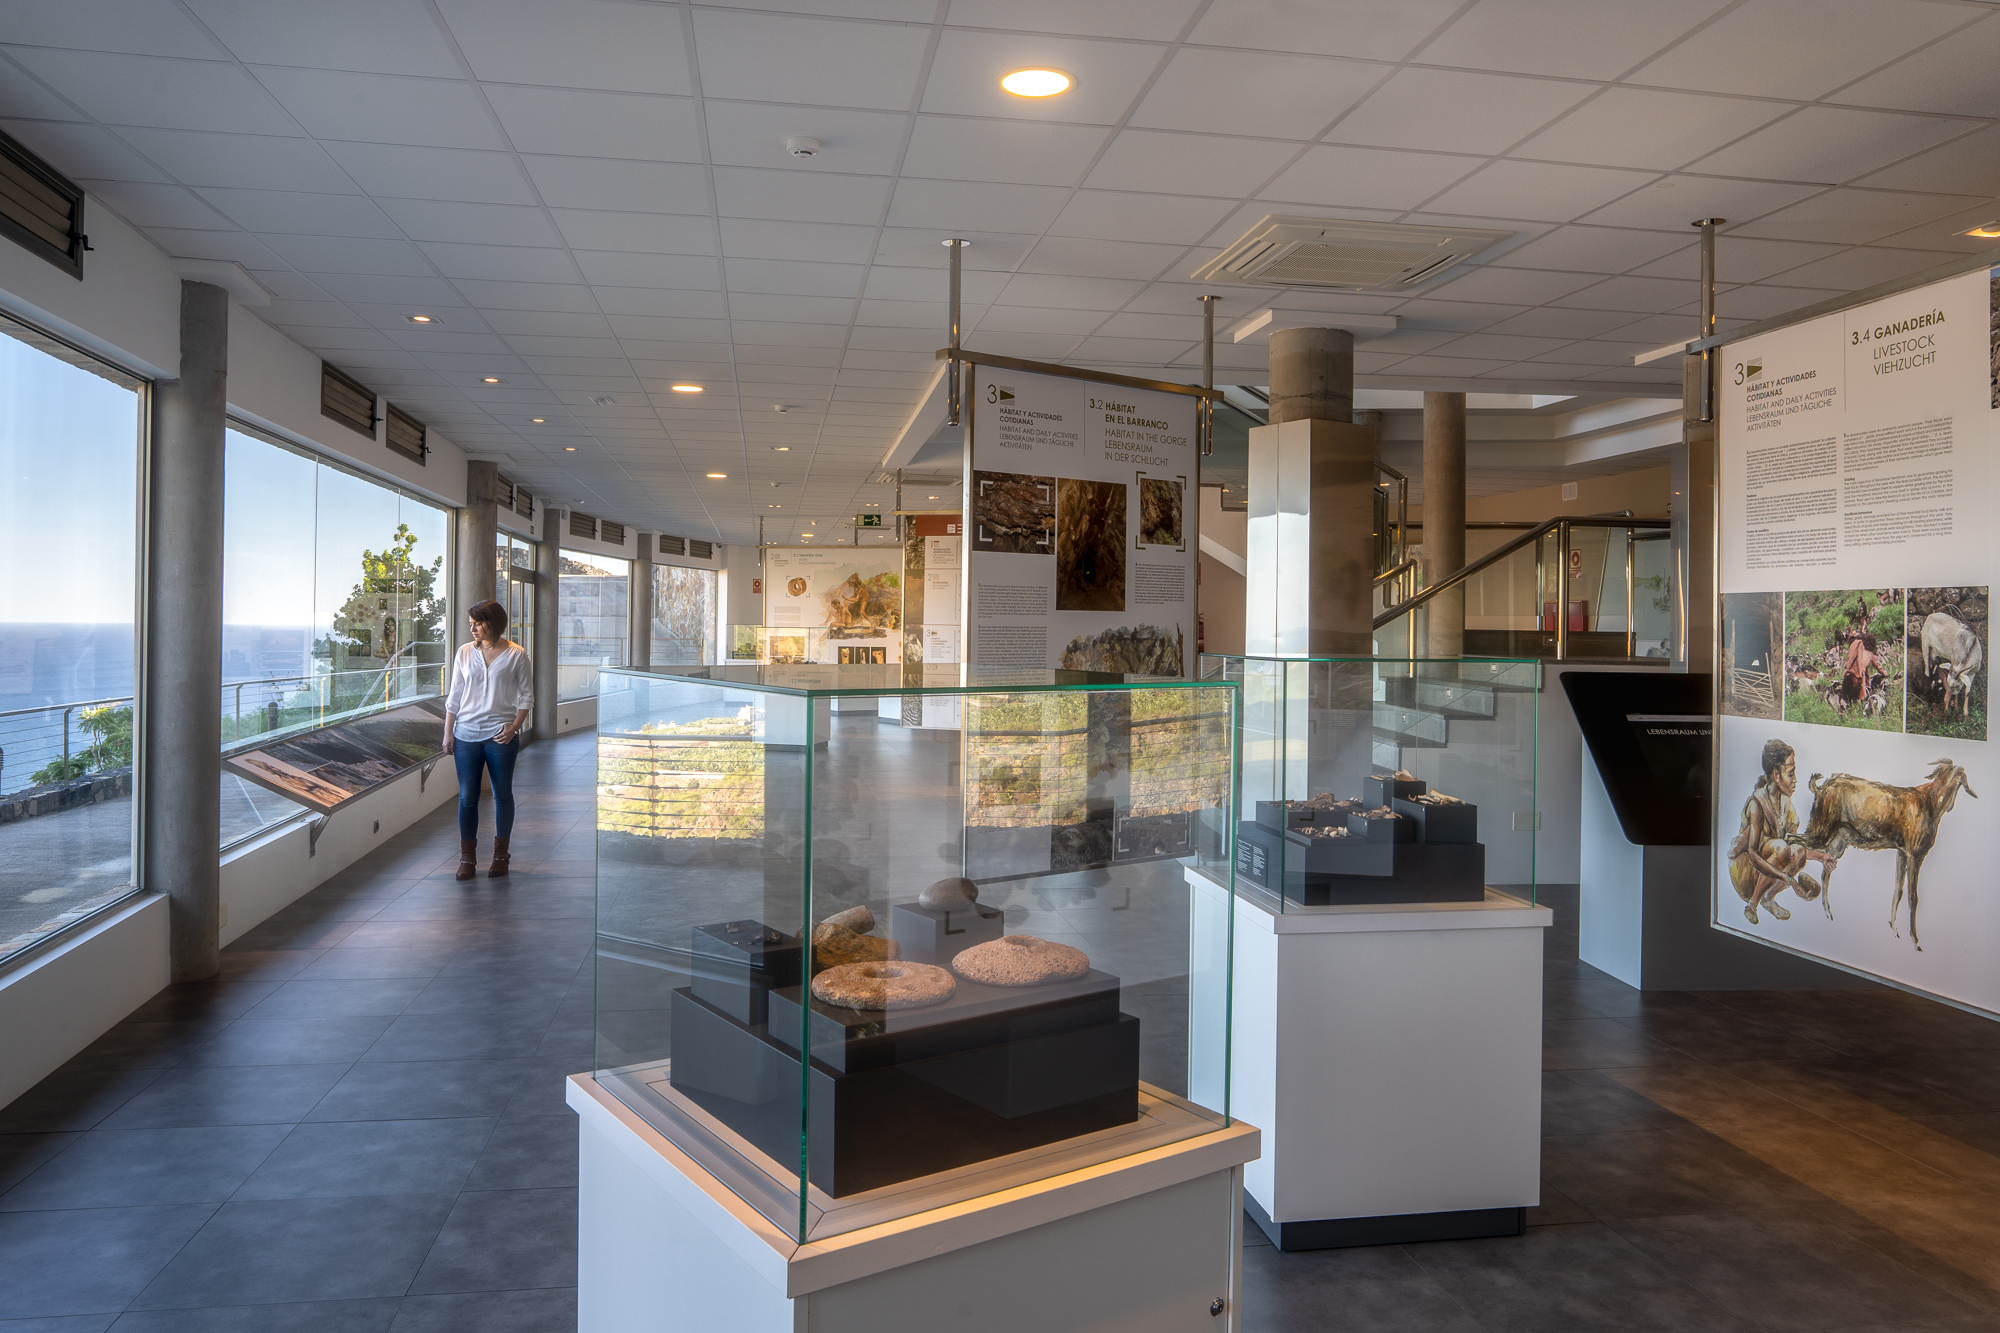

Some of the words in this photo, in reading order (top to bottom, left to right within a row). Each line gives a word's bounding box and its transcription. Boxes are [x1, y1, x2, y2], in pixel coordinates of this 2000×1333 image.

[1852, 328, 1870, 345] 3.4
[1874, 309, 1945, 339] GANADERÍA
[1874, 334, 1935, 360] LIVESTOCK
[1874, 351, 1936, 375] VIEHZUCHT
[1735, 363, 1744, 385] 3
[1747, 381, 1769, 393] HÁBITAT
[1776, 370, 1816, 386] ACTIVIDADES
[987, 384, 997, 404] 3
[1747, 388, 1782, 402] COTIDIANAS
[1747, 402, 1769, 413] HABITAT
[1771, 399, 1784, 408] AND
[1786, 395, 1803, 405] DAILY
[1805, 387, 1837, 401] ACTIVITIES
[1000, 407, 1021, 416] HÁBITAT
[1028, 412, 1062, 421] ACTIVIDADES
[1090, 398, 1103, 409] 3.2
[1106, 401, 1135, 414] HÁBITAT
[1747, 409, 1784, 422] LEBENSRAUM
[1786, 405, 1799, 415] UND
[1801, 398, 1832, 412] TÄGLICHE
[1000, 416, 1033, 426] COTIDIANAS
[1106, 414, 1115, 423] EN
[1118, 416, 1124, 424] EL
[1127, 417, 1168, 430] BARRANCO
[1747, 419, 1781, 432] AKTIVITÄTEN
[1000, 433, 1034, 442] LEBENSRAUM
[1049, 438, 1074, 447] TÄGLICHE
[1052, 432, 1078, 440] ACTIVITIES
[1105, 428, 1135, 439] HABITAT
[1137, 432, 1144, 440] IN
[1146, 433, 1158, 442] THE
[1160, 435, 1187, 446] GORGE
[999, 442, 1032, 450] AKTIVITÄTEN
[1105, 440, 1152, 453] LEBENSRAUM
[1105, 452, 1112, 460] IN
[1115, 453, 1129, 462] DER
[1131, 455, 1168, 466] SCHLUCHT
